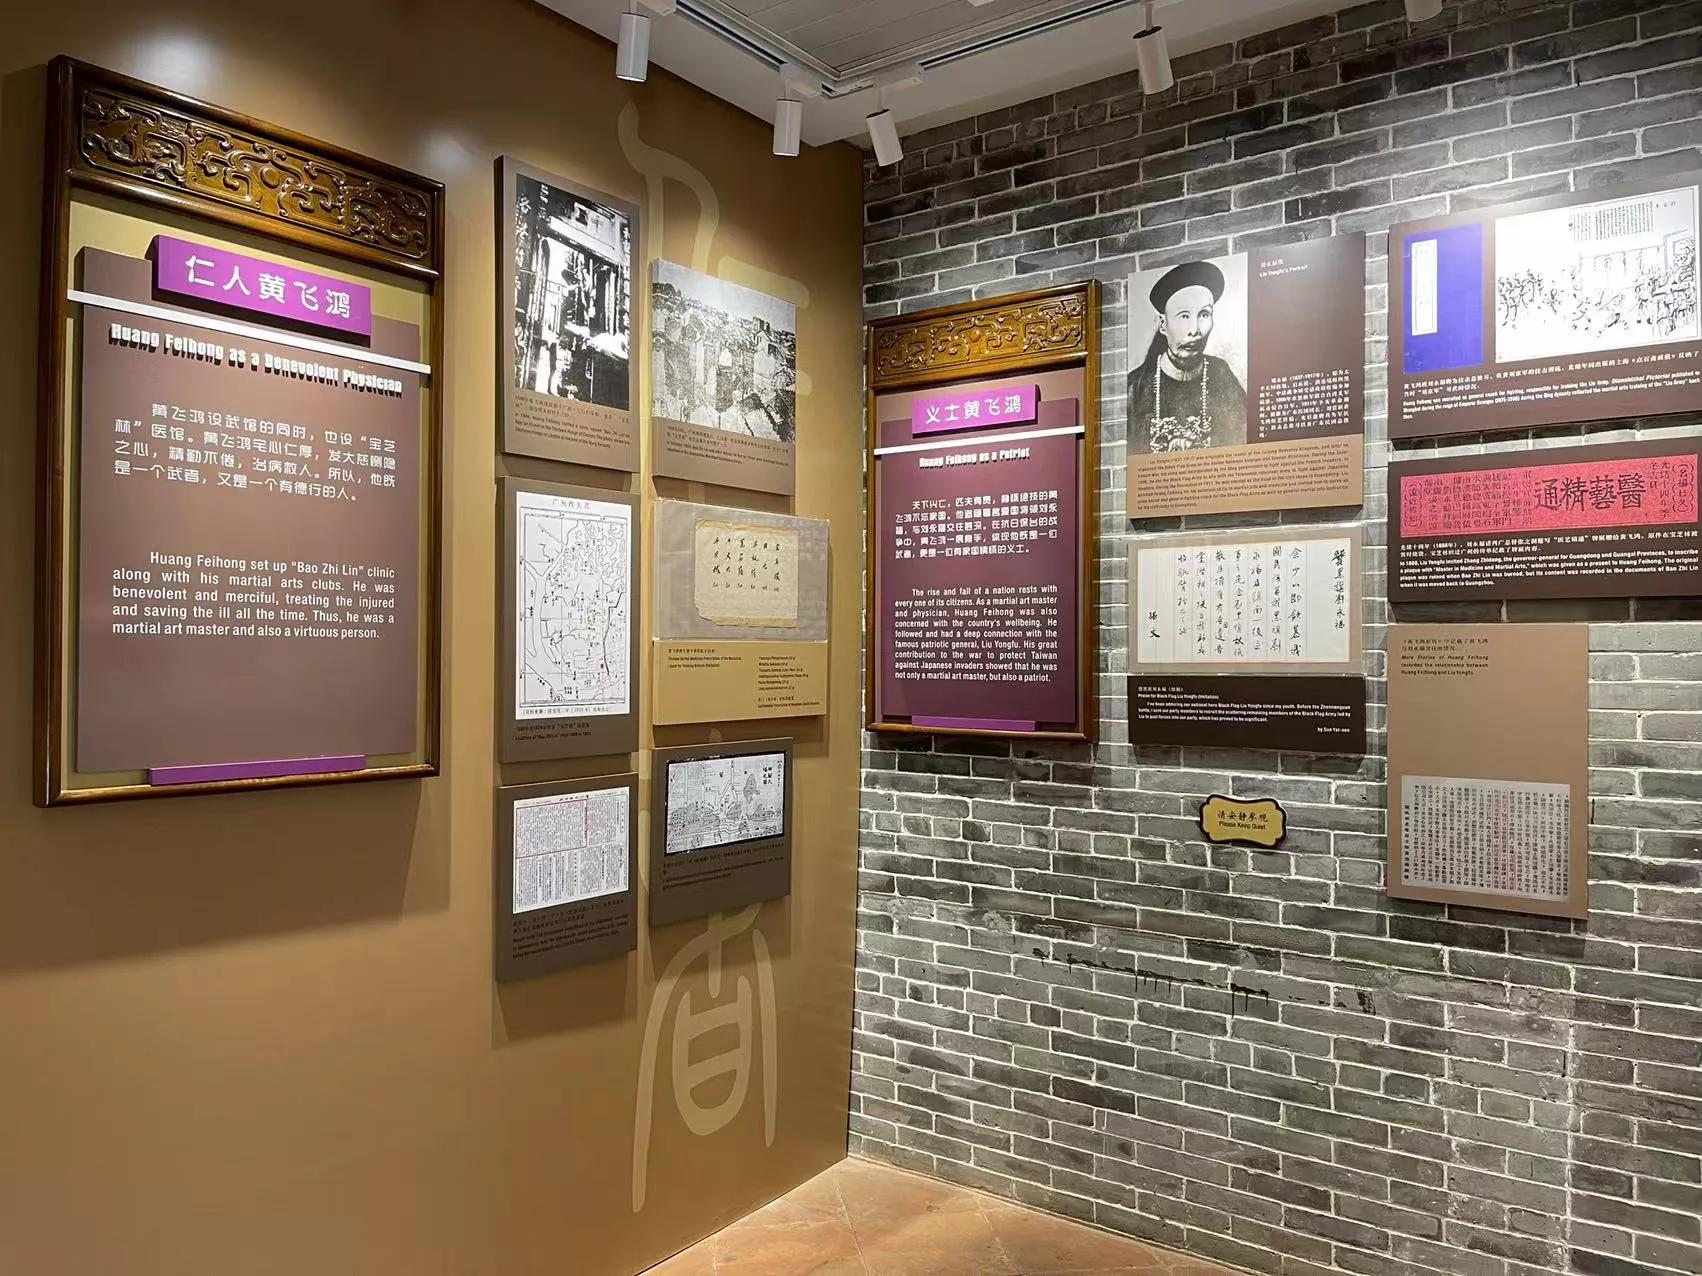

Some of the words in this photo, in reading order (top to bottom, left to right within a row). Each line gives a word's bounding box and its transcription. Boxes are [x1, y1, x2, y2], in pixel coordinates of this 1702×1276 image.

[185, 256, 351, 319] 仁人黄飞鸿
[925, 395, 1021, 425] 义士黄飞鸿
[114, 459, 356, 501] 是一个武者，又是一个有德行的人。
[151, 552, 191, 568] Huang
[197, 555, 245, 571] Feihong
[251, 560, 268, 570] set
[273, 563, 287, 573] up
[322, 563, 338, 574] Zhi
[368, 567, 394, 577] clinic
[113, 569, 150, 583] along
[162, 571, 189, 582] with
[201, 572, 218, 584] his
[230, 576, 271, 586] martial
[281, 578, 302, 588] arts
[312, 579, 343, 590] clubs.
[354, 581, 366, 591] He
[375, 585, 394, 593] was
[113, 586, 187, 599] benevolent
[195, 590, 217, 601] and
[226, 592, 278, 605] merciful,
[286, 594, 329, 607] treating
[336, 596, 352, 606] the
[359, 597, 394, 609] injured
[960, 587, 970, 595] fall
[113, 604, 137, 615] and
[144, 605, 186, 619] saving
[193, 606, 213, 618] the
[219, 607, 229, 618] ill
[236, 608, 250, 619] all
[256, 609, 274, 619] the
[280, 609, 307, 620] time.
[313, 610, 341, 623] Thus,
[347, 612, 359, 622] he
[364, 615, 383, 623] was
[389, 615, 394, 623] a
[955, 609, 977, 617] Huang
[984, 609, 1013, 617] Feihong
[113, 622, 160, 633] martial
[165, 623, 182, 634] art
[186, 624, 229, 635] master
[233, 625, 254, 635] and
[258, 625, 281, 636] also
[285, 628, 290, 636] a
[294, 626, 338, 637] virtuous
[341, 629, 379, 639] person.
[964, 630, 980, 638] deep
[1038, 641, 1057, 650] great
[1000, 652, 1025, 660] protect
[907, 672, 920, 680] only
